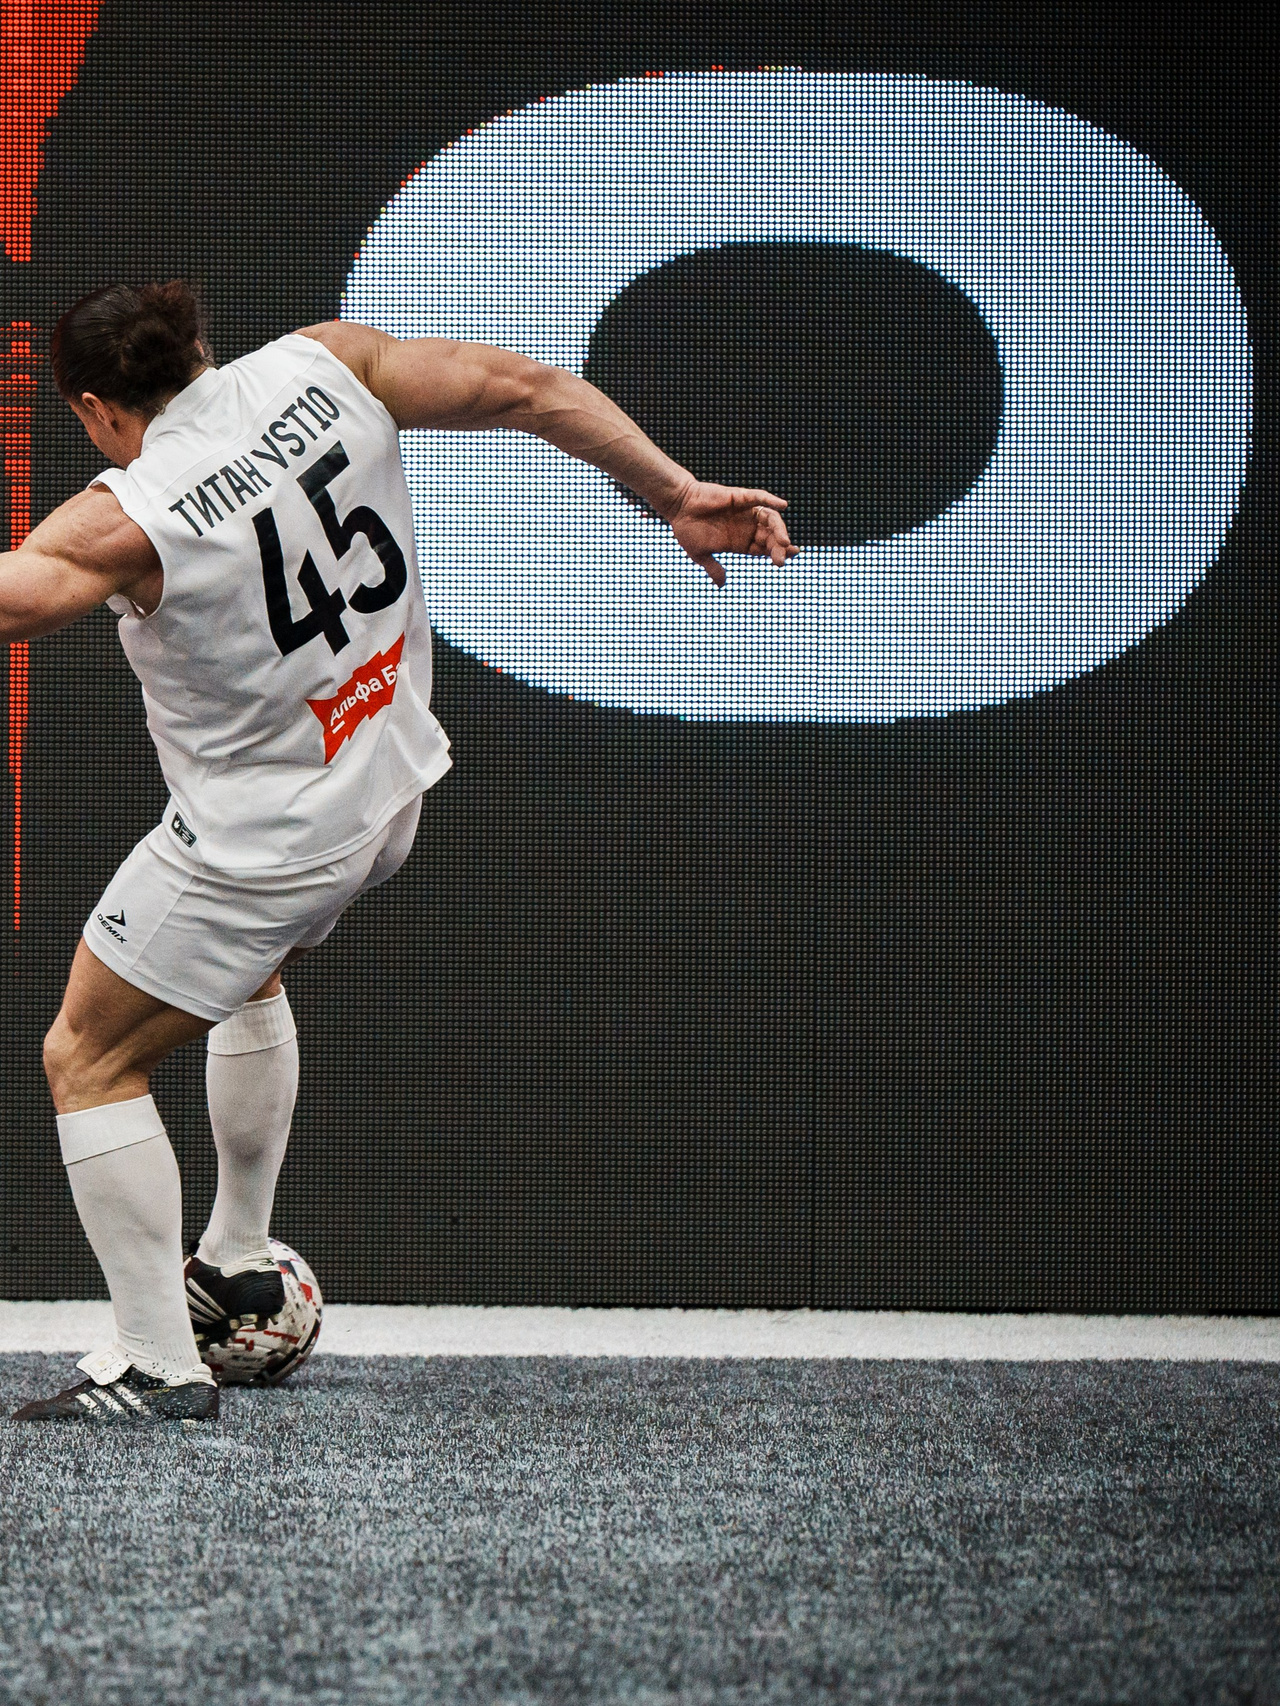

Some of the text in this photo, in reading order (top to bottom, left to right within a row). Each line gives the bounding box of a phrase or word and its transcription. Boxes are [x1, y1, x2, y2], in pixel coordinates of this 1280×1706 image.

[167, 454, 273, 538] ТИТАН
[251, 439, 408, 657] 45
[330, 676, 384, 727] Альфа
[96, 913, 128, 945] DEMIX
